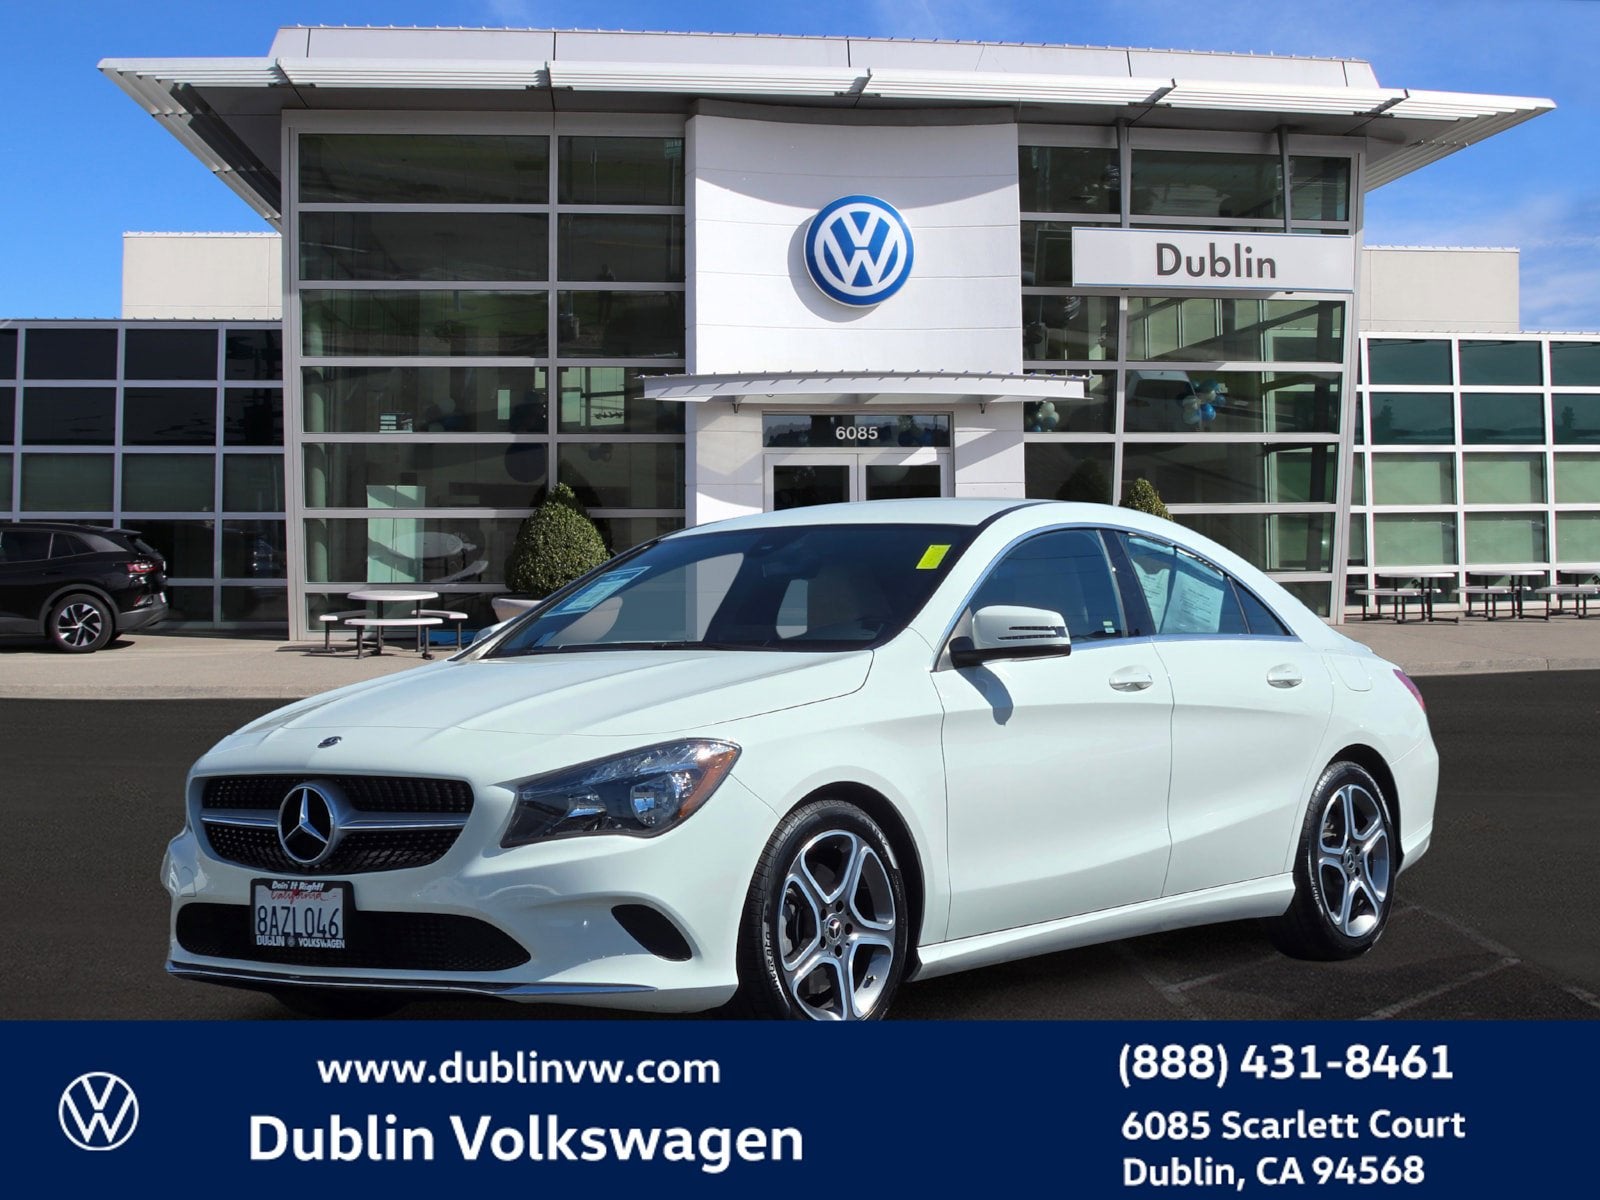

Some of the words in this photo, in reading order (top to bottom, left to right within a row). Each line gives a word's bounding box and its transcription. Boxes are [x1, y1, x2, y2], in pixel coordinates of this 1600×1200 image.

[1156, 242, 1277, 279] Dublin
[835, 426, 878, 441] 6085
[290, 881, 298, 890] It
[299, 882, 324, 892] Right!
[257, 905, 340, 938] 8AZL046
[256, 935, 285, 946] DUBLIN
[298, 938, 345, 948] VOLKSWAGEN
